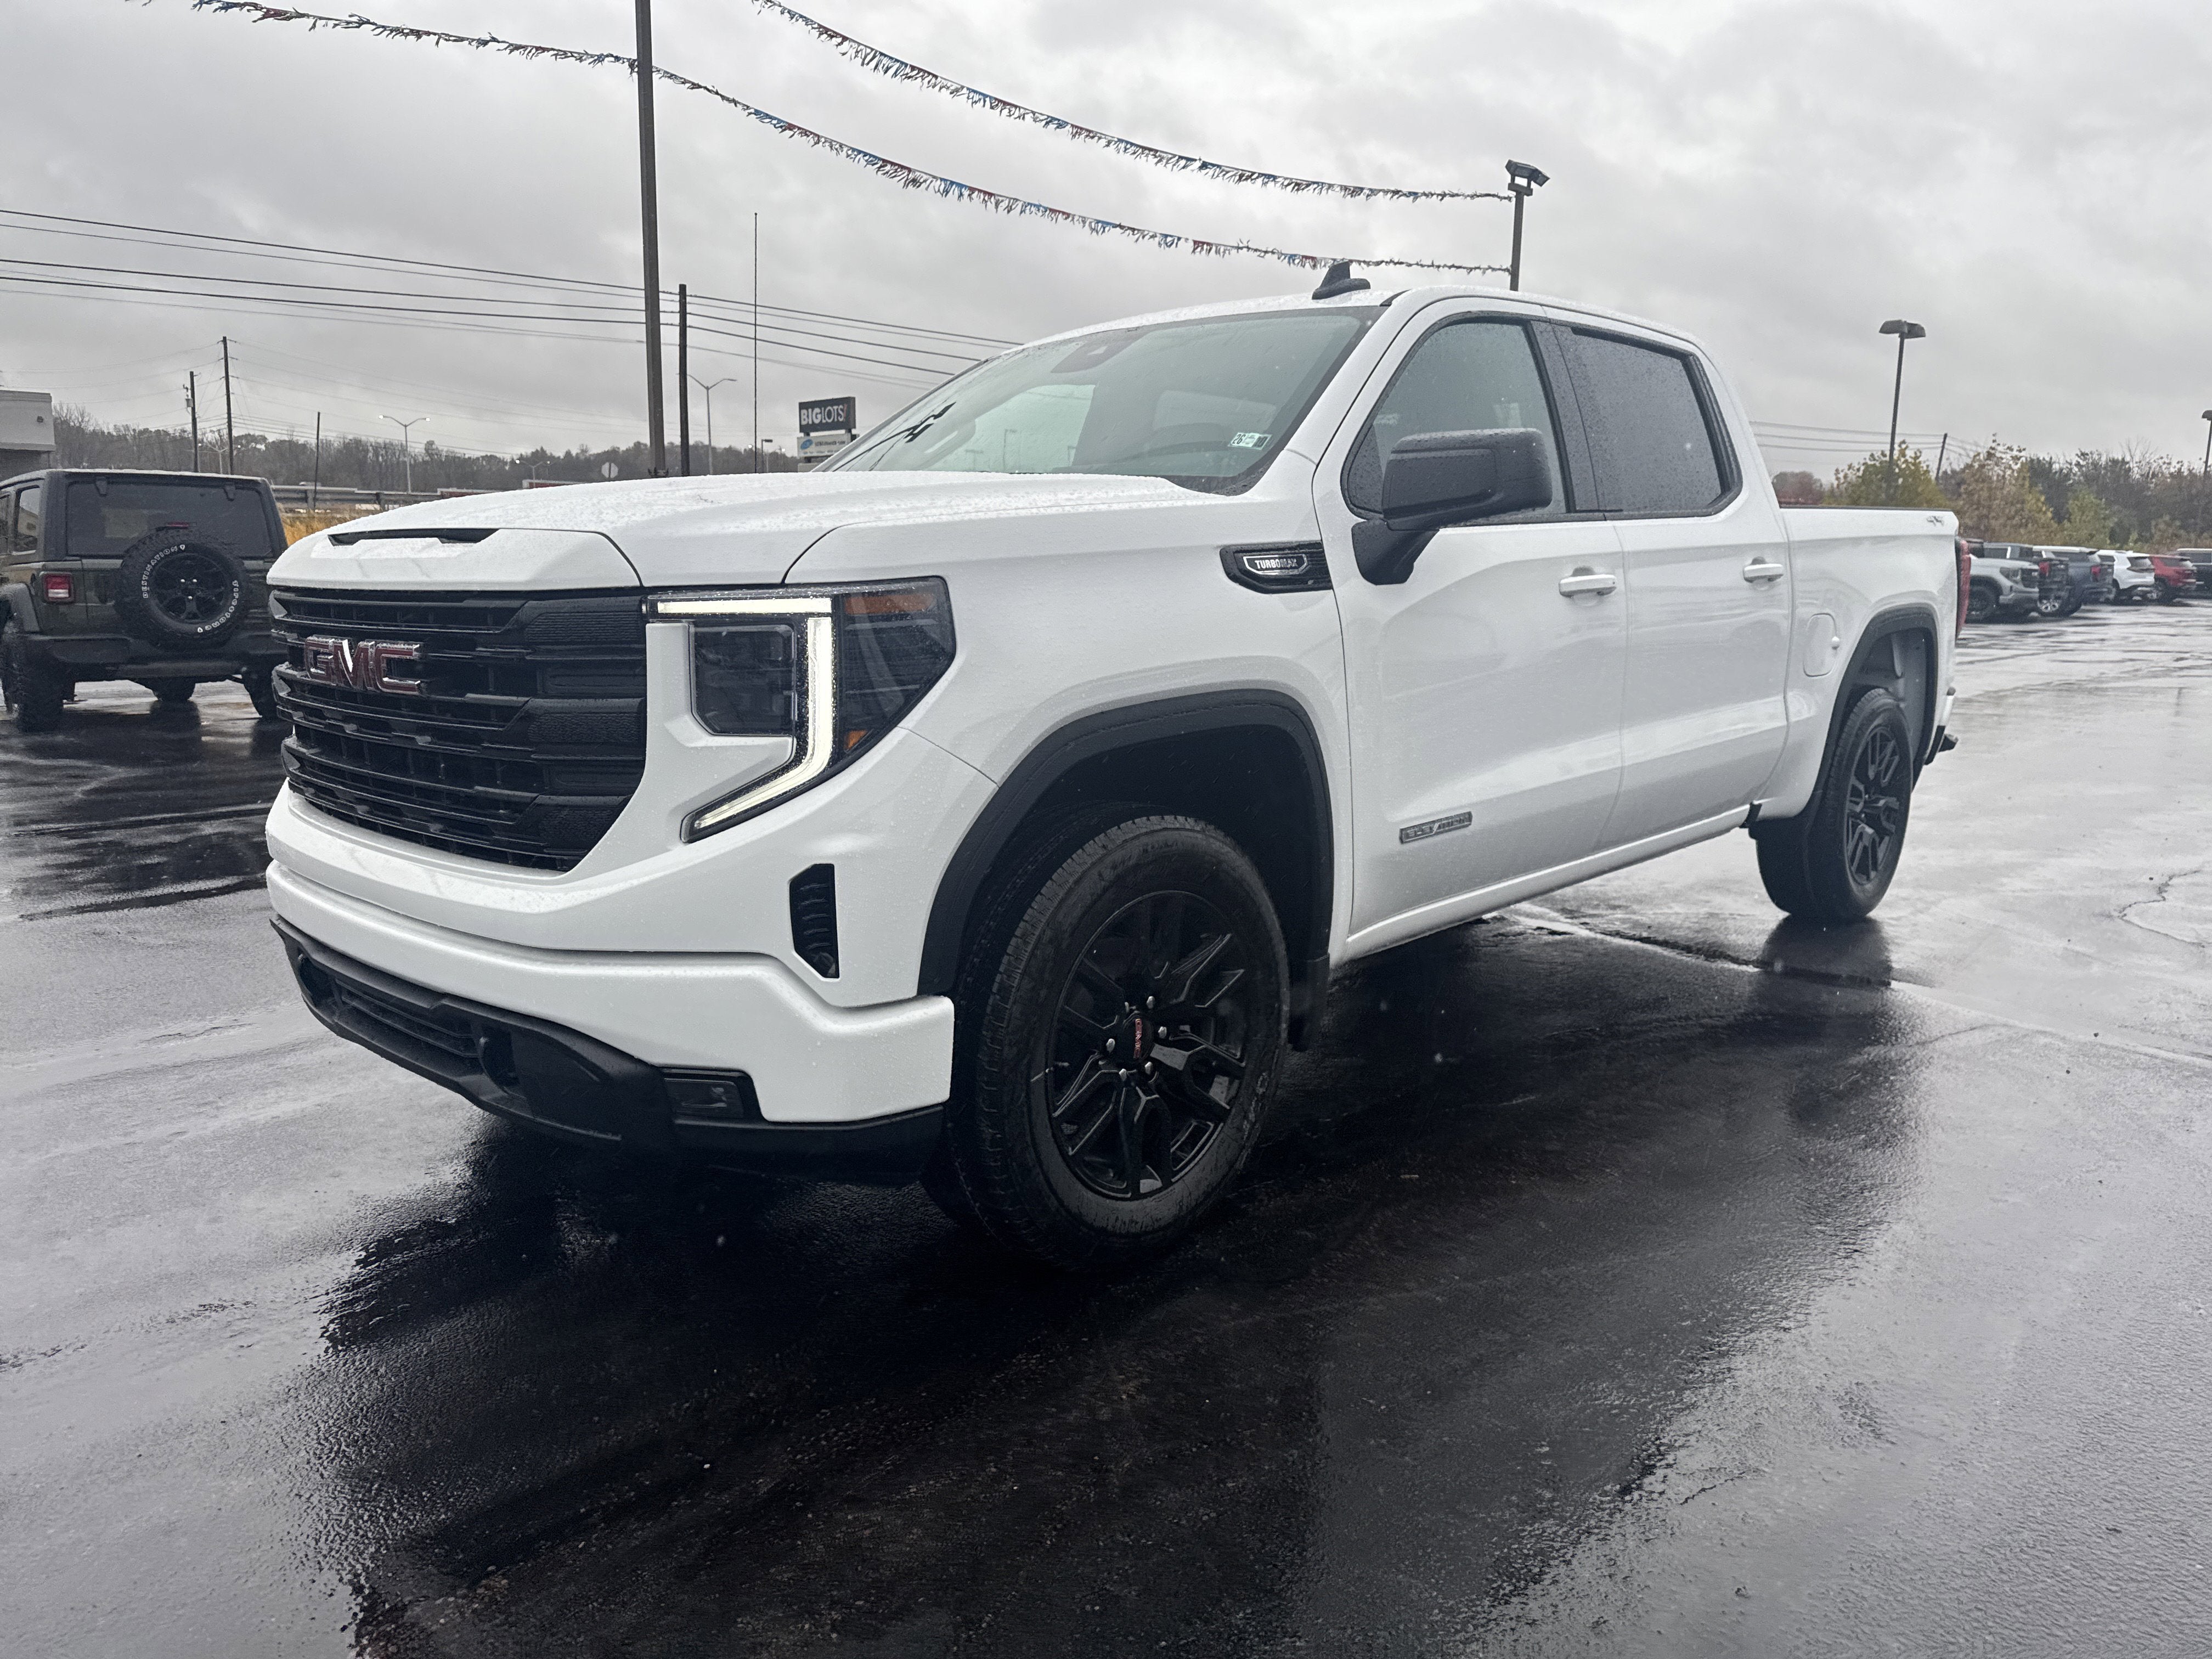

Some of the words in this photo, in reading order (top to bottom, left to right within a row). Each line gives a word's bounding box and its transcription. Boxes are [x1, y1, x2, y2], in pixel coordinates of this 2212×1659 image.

[800, 408, 822, 425] BIG
[822, 404, 848, 423] LOTS!
[1232, 434, 1246, 444] 26
[142, 546, 178, 599] DESTINATION
[1254, 558, 1298, 569] TURBOMAX
[304, 635, 421, 695] GMC
